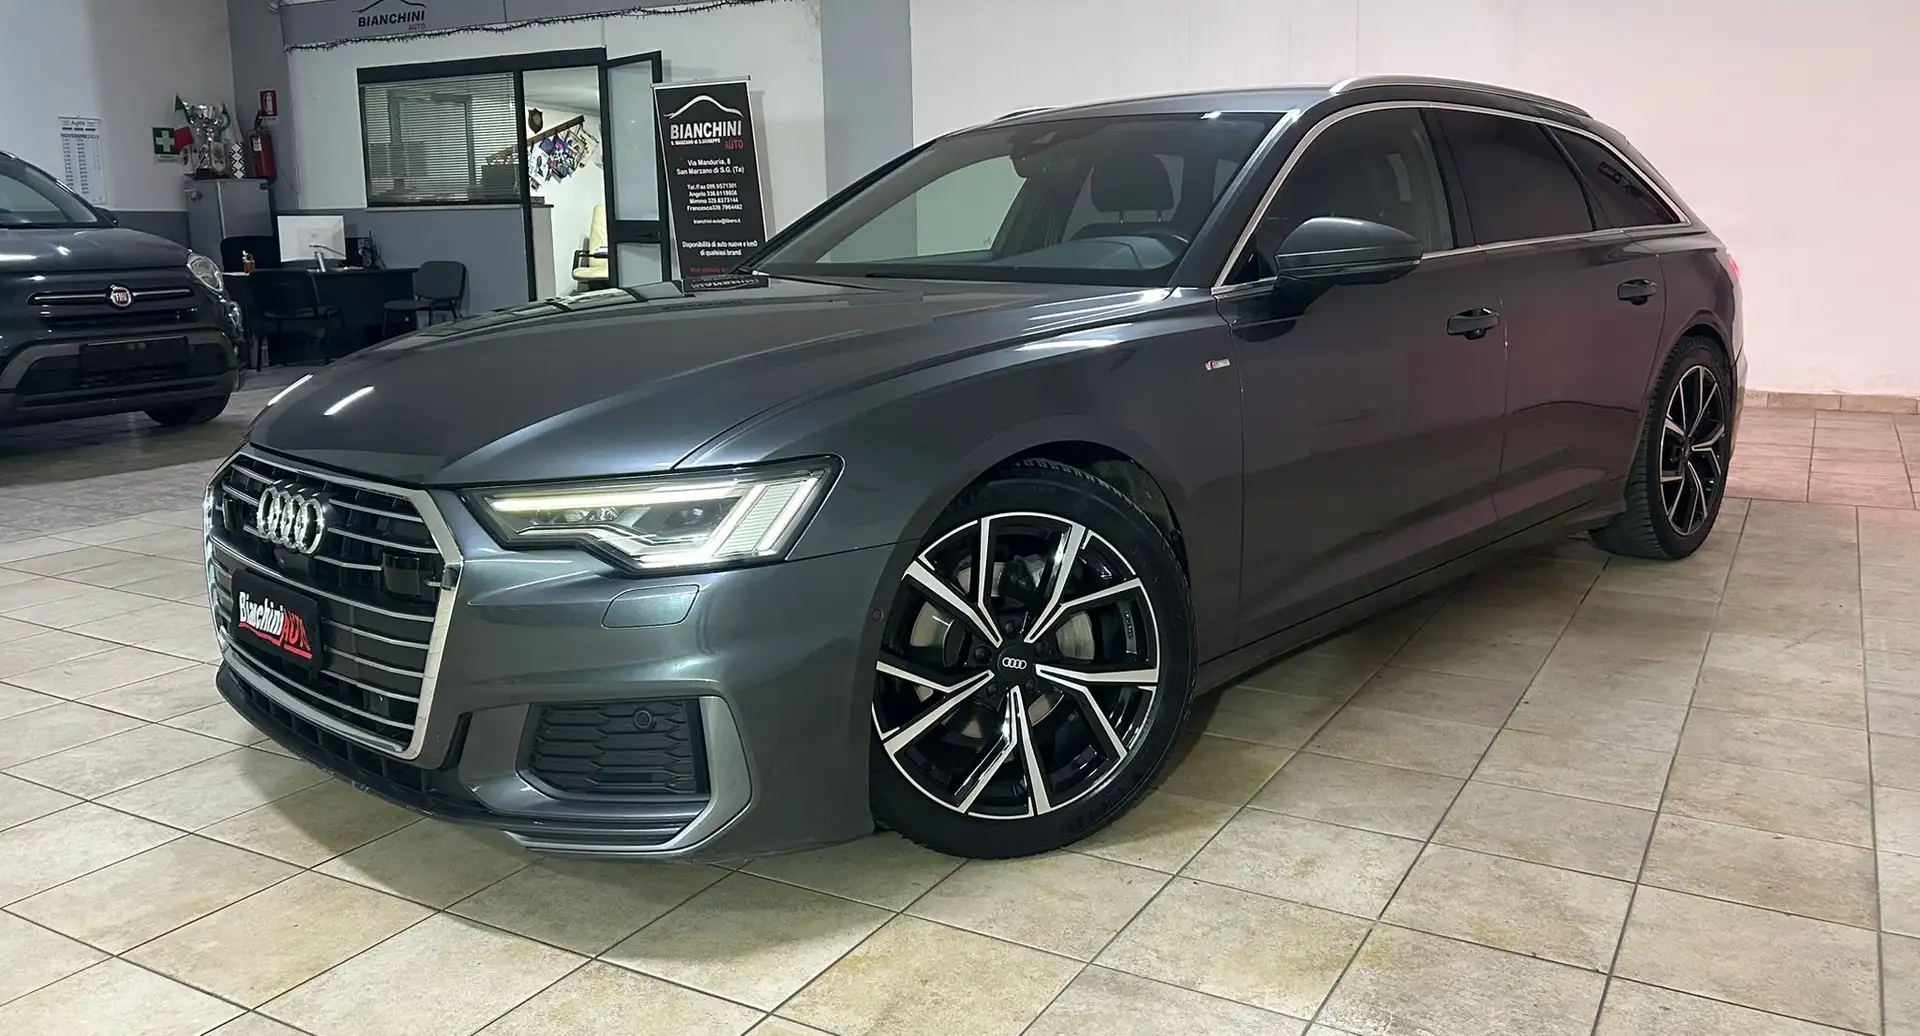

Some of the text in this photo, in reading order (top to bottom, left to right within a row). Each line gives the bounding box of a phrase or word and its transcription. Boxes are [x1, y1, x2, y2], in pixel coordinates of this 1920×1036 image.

[358, 10, 425, 27] BIANCHINI
[670, 121, 742, 139] BIANCHINI
[725, 139, 744, 149] AUTO
[727, 157, 731, 165] 8
[732, 166, 745, 174] (Ta)
[239, 591, 284, 636] Bianchini
